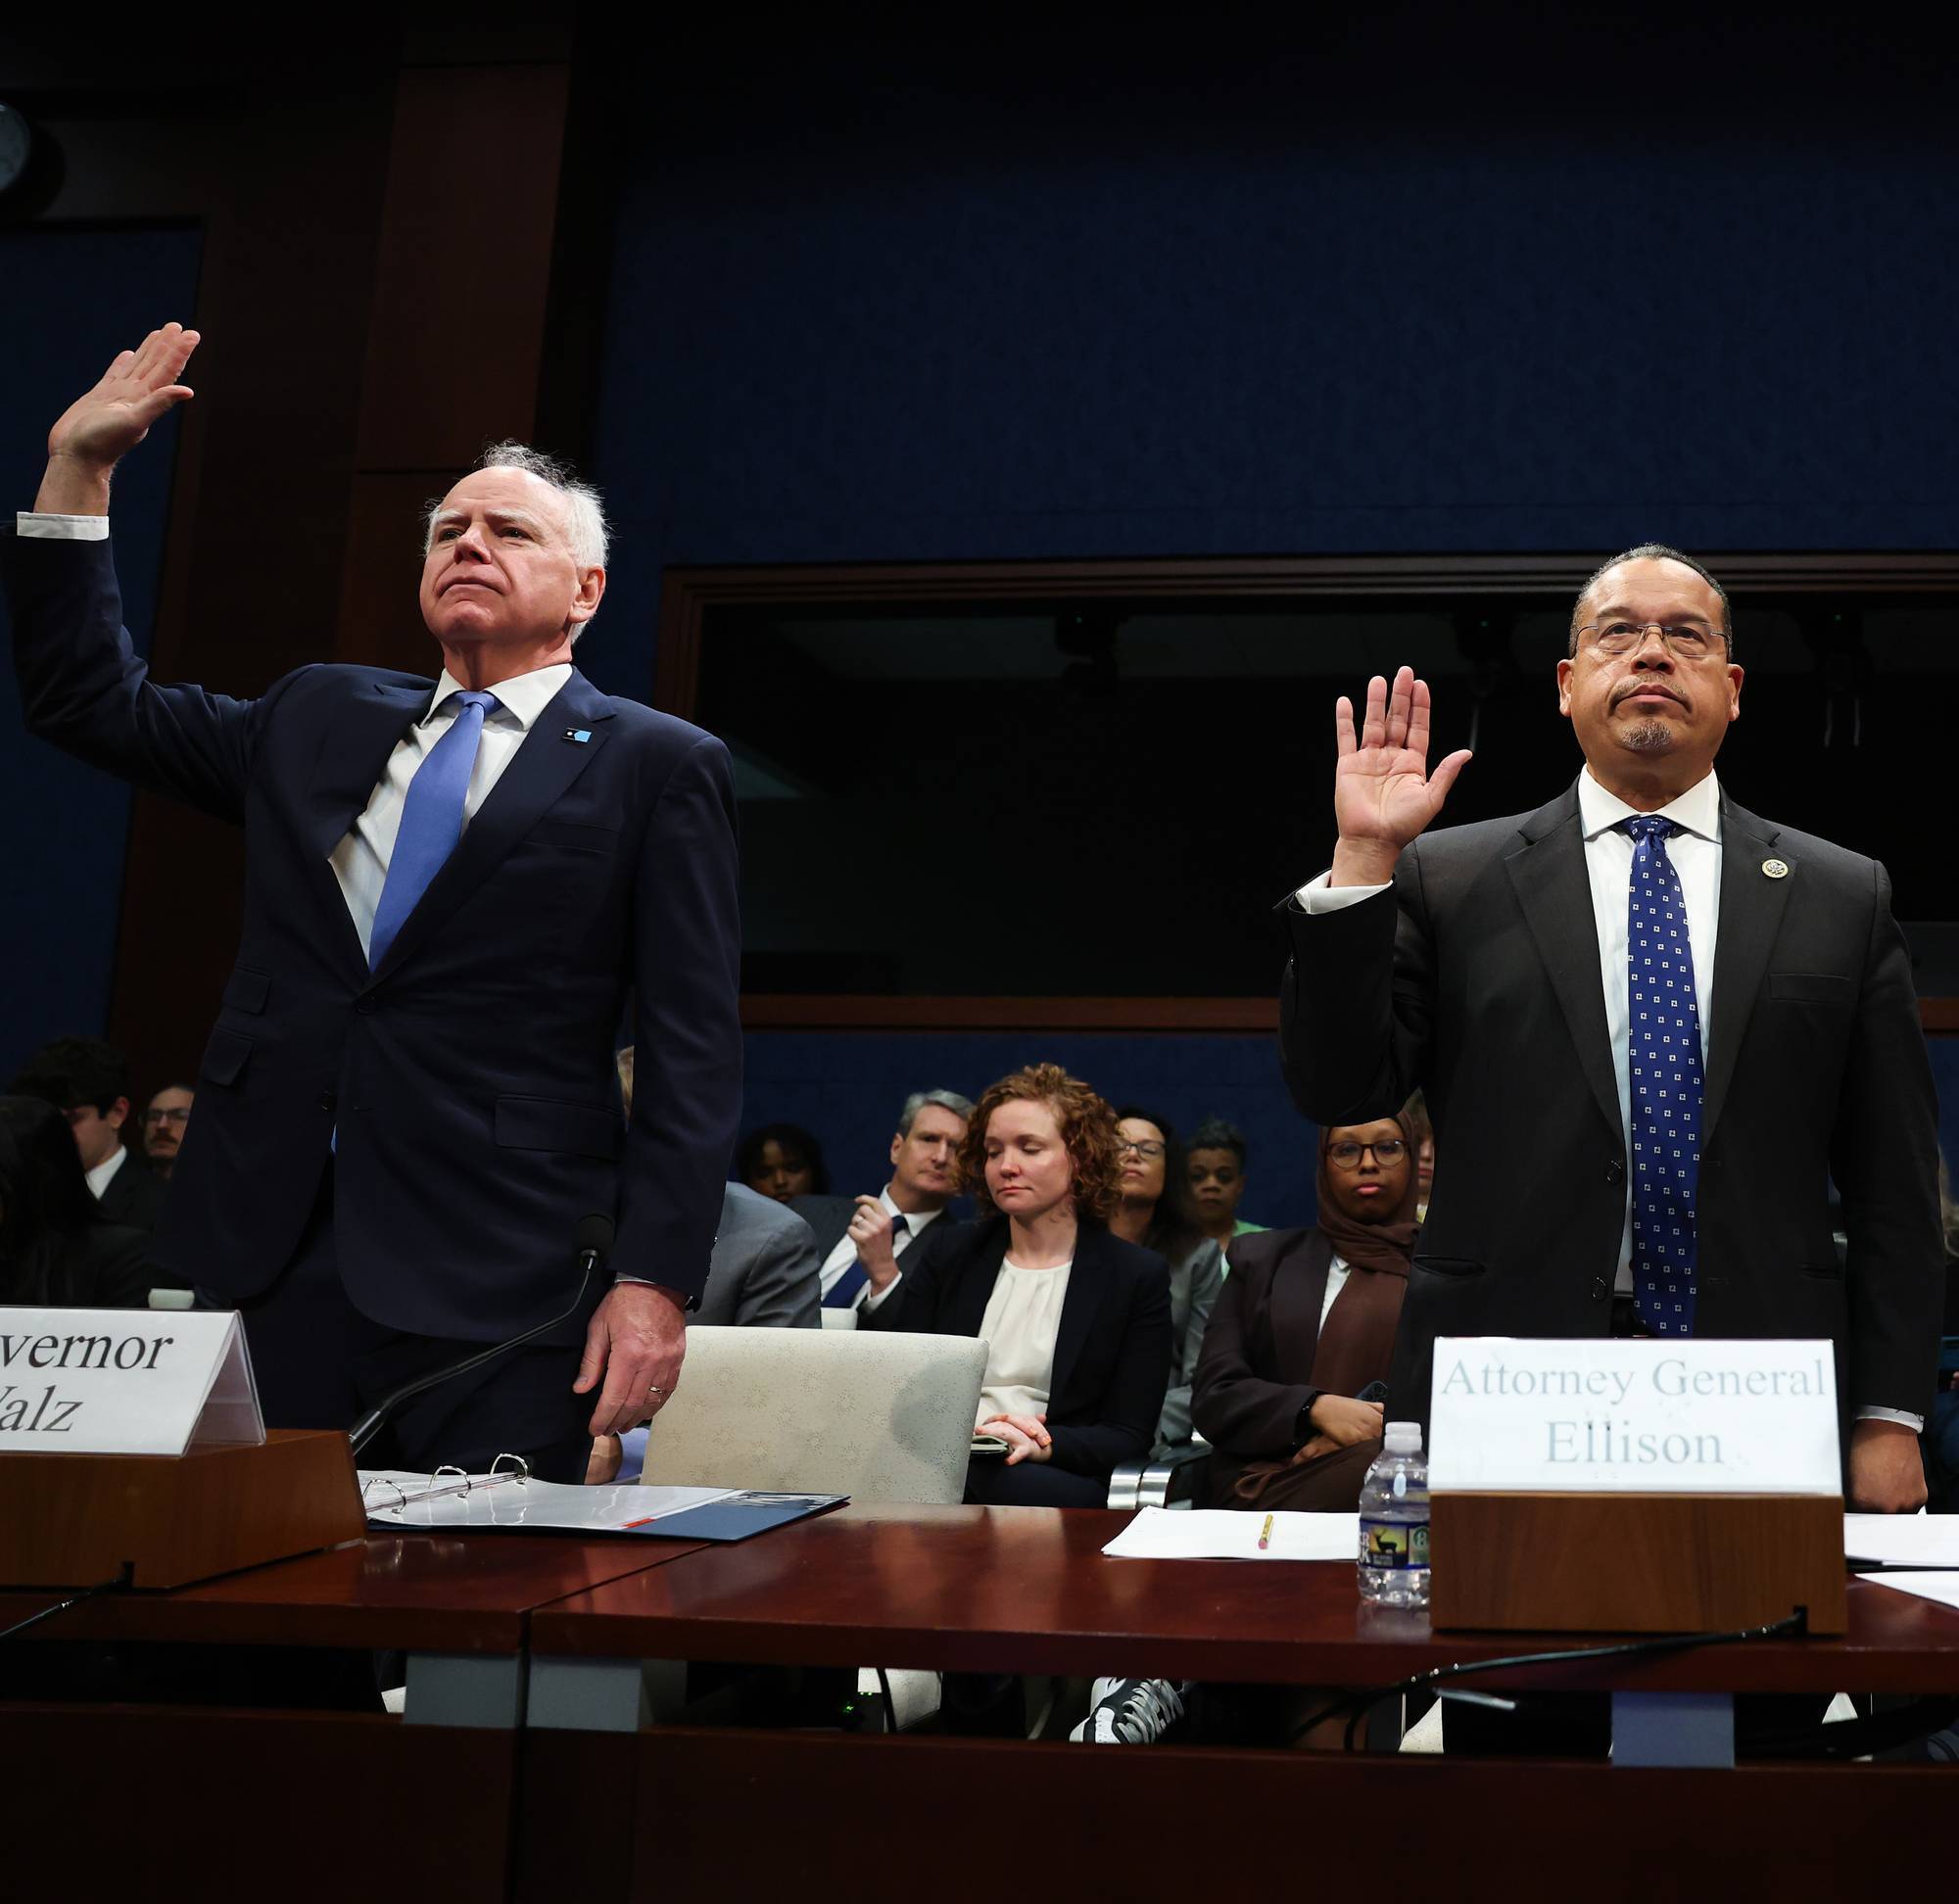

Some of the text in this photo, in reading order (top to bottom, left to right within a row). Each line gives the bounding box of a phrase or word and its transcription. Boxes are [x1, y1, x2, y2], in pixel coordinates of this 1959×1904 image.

[1440, 1357, 1828, 1405] Attorney General
[0, 1384, 84, 1433] alz
[1545, 1416, 1725, 1465] Ellison
